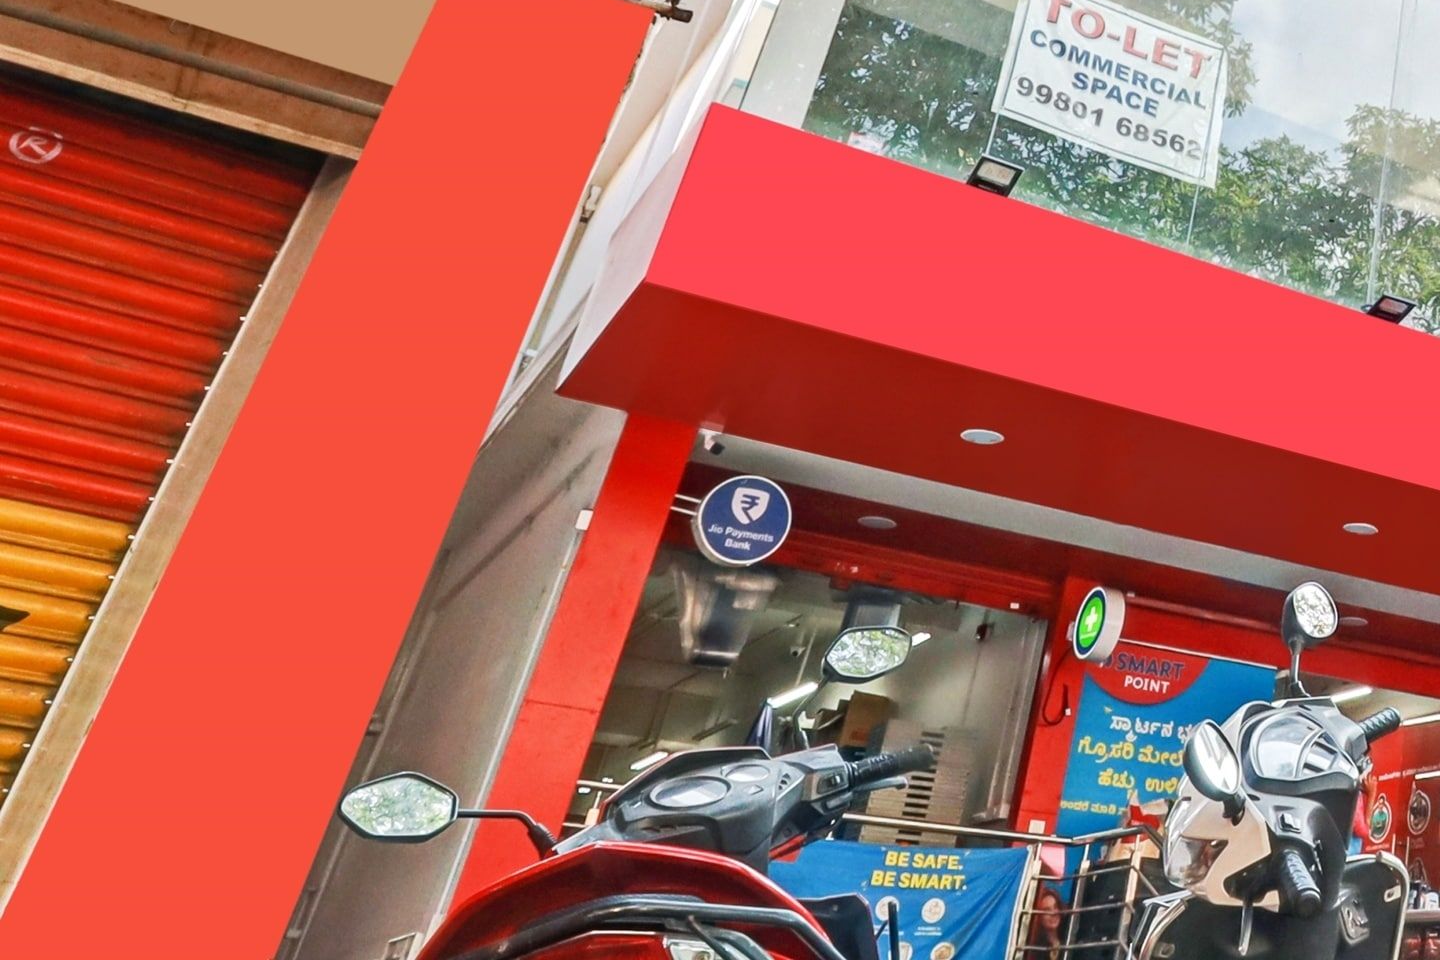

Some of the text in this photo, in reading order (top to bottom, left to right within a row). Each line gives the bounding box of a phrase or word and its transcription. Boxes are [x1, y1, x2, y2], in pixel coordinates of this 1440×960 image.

[1030, 29, 1207, 110] COMMERCIAL
[1072, 72, 1160, 118] SPACE
[1016, 76, 1201, 160] 99801 68562
[708, 524, 774, 543] Jio Payments
[724, 538, 751, 551] Bank
[1116, 652, 1184, 680] SMART
[1124, 675, 1170, 694] POINT
[885, 850, 964, 870] BE SAFE.
[871, 870, 967, 890] BE SMART.
